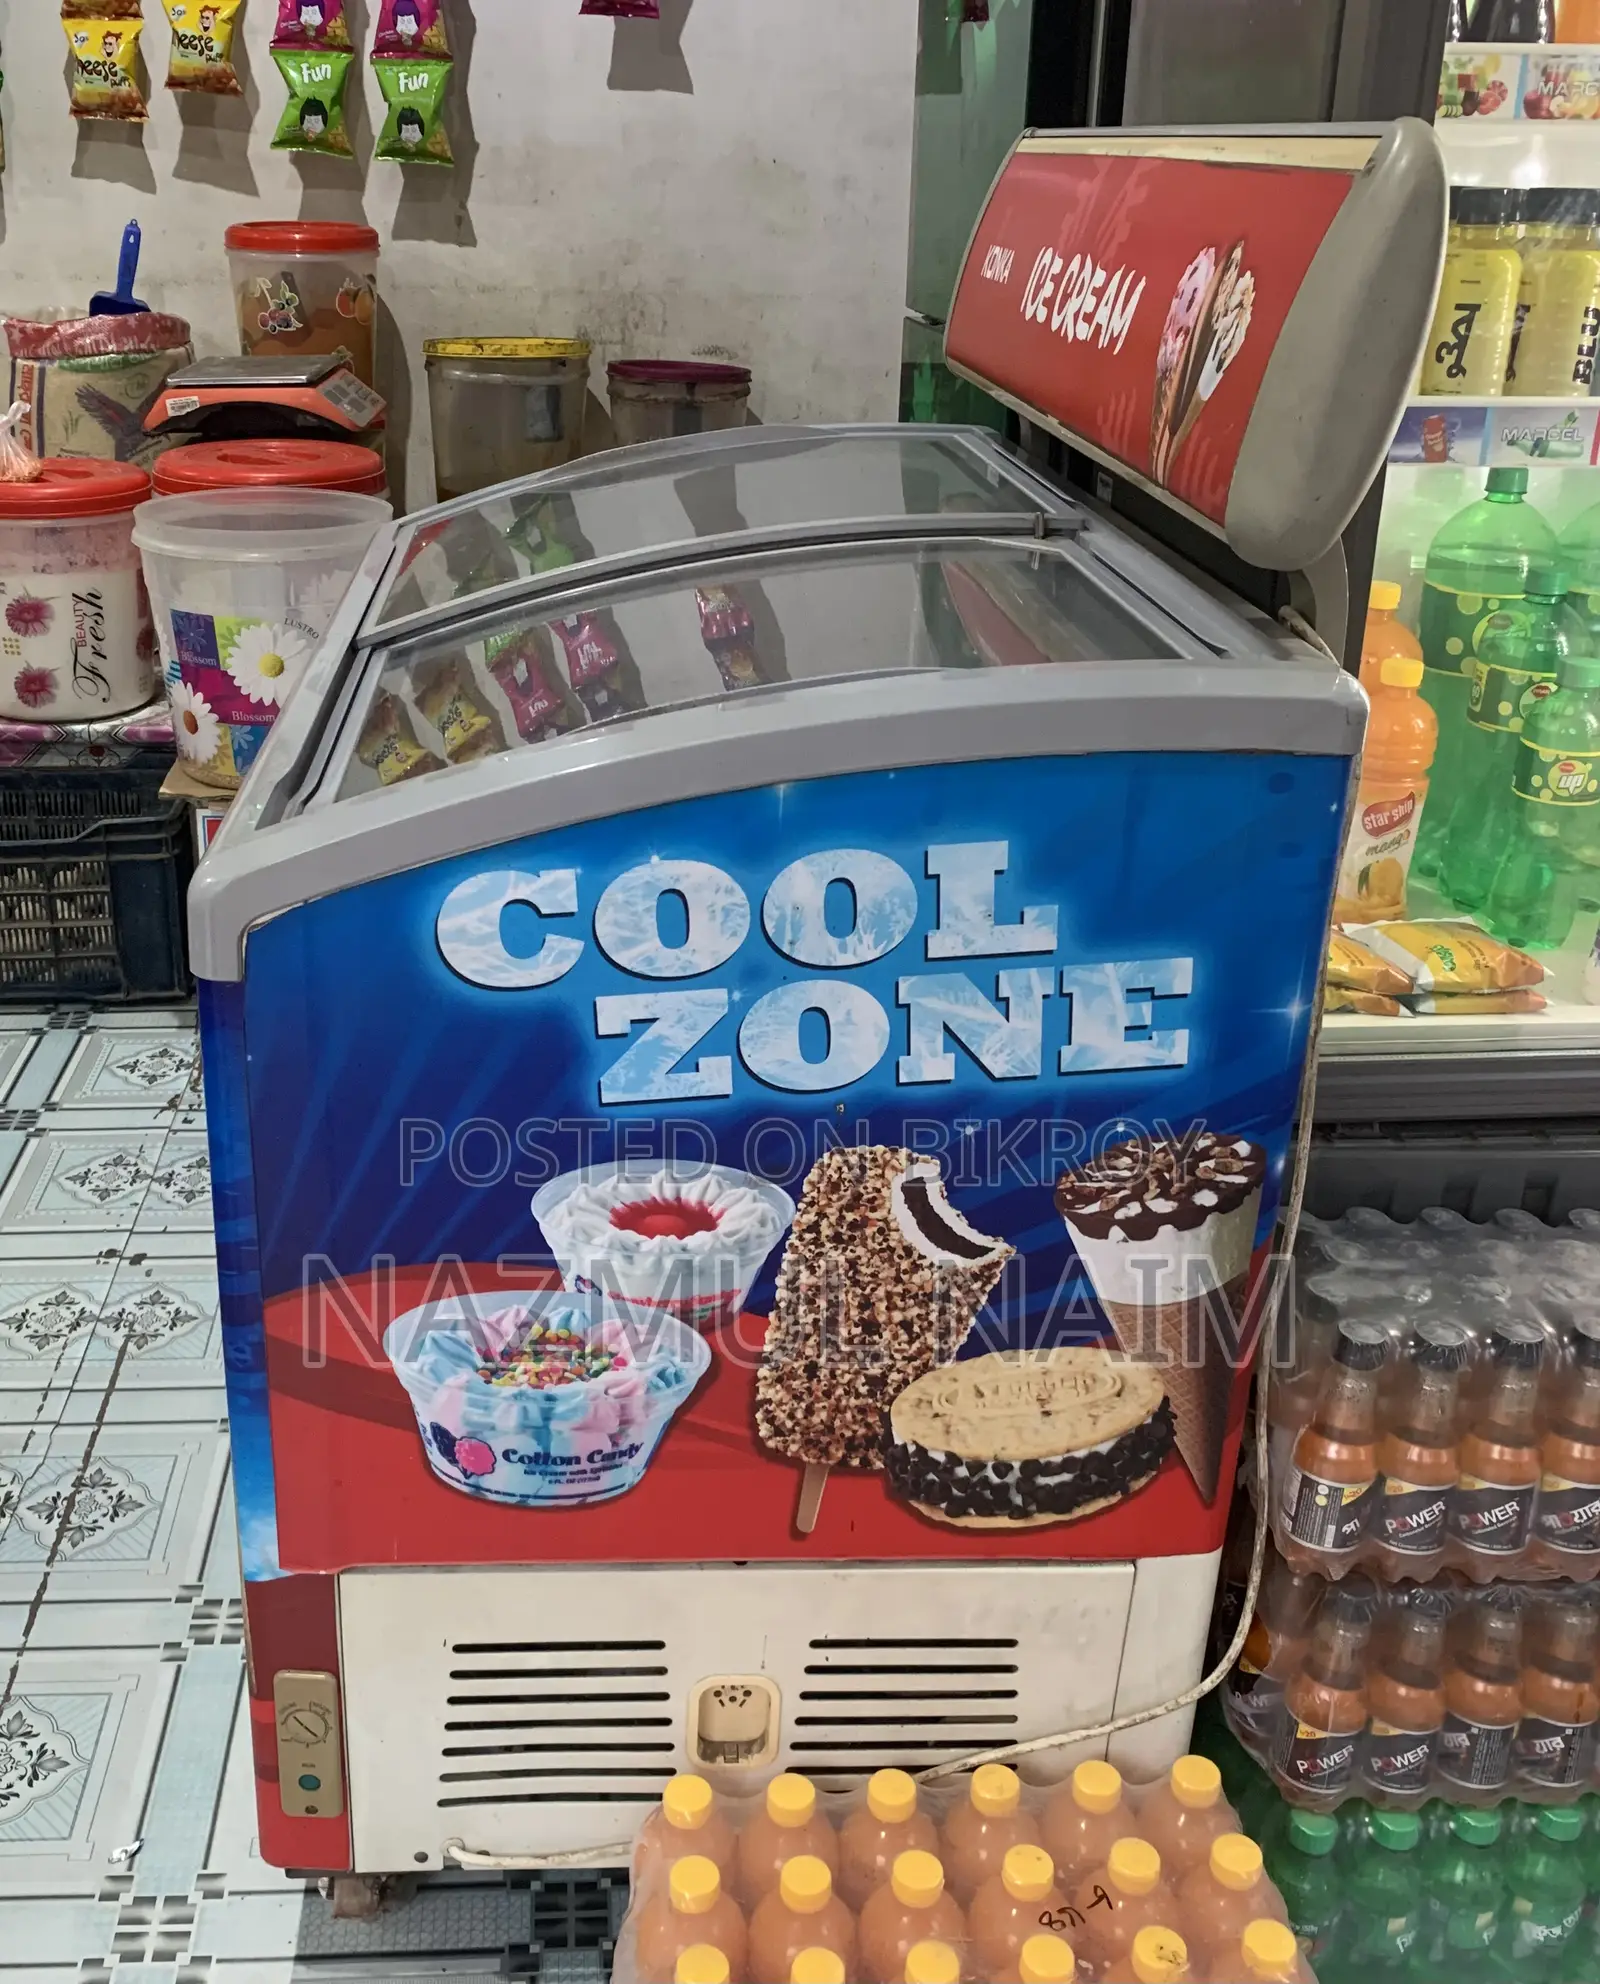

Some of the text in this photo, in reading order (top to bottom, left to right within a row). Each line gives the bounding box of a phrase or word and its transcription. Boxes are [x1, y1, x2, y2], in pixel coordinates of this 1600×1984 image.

[300, 62, 332, 84] Fun
[398, 72, 429, 93] Fun
[1020, 246, 1146, 355] ICE CREAM
[1502, 427, 1584, 442] MARCEL
[72, 599, 87, 648] BEAUTY
[284, 617, 320, 640] LUSTRO
[70, 587, 111, 703] Fresh
[182, 652, 217, 667] Blossom
[232, 710, 276, 722] Blossom
[1557, 773, 1585, 796] up
[1363, 799, 1413, 830] star ship
[436, 840, 1059, 991] COOL
[594, 957, 1194, 1105] ZONE
[502, 1442, 644, 1466] Cotton Candy
[1385, 1501, 1446, 1534] POWER
[1458, 1501, 1521, 1530] POWER
[1296, 1744, 1354, 1774] POWER
[1371, 1744, 1430, 1773] POWER
